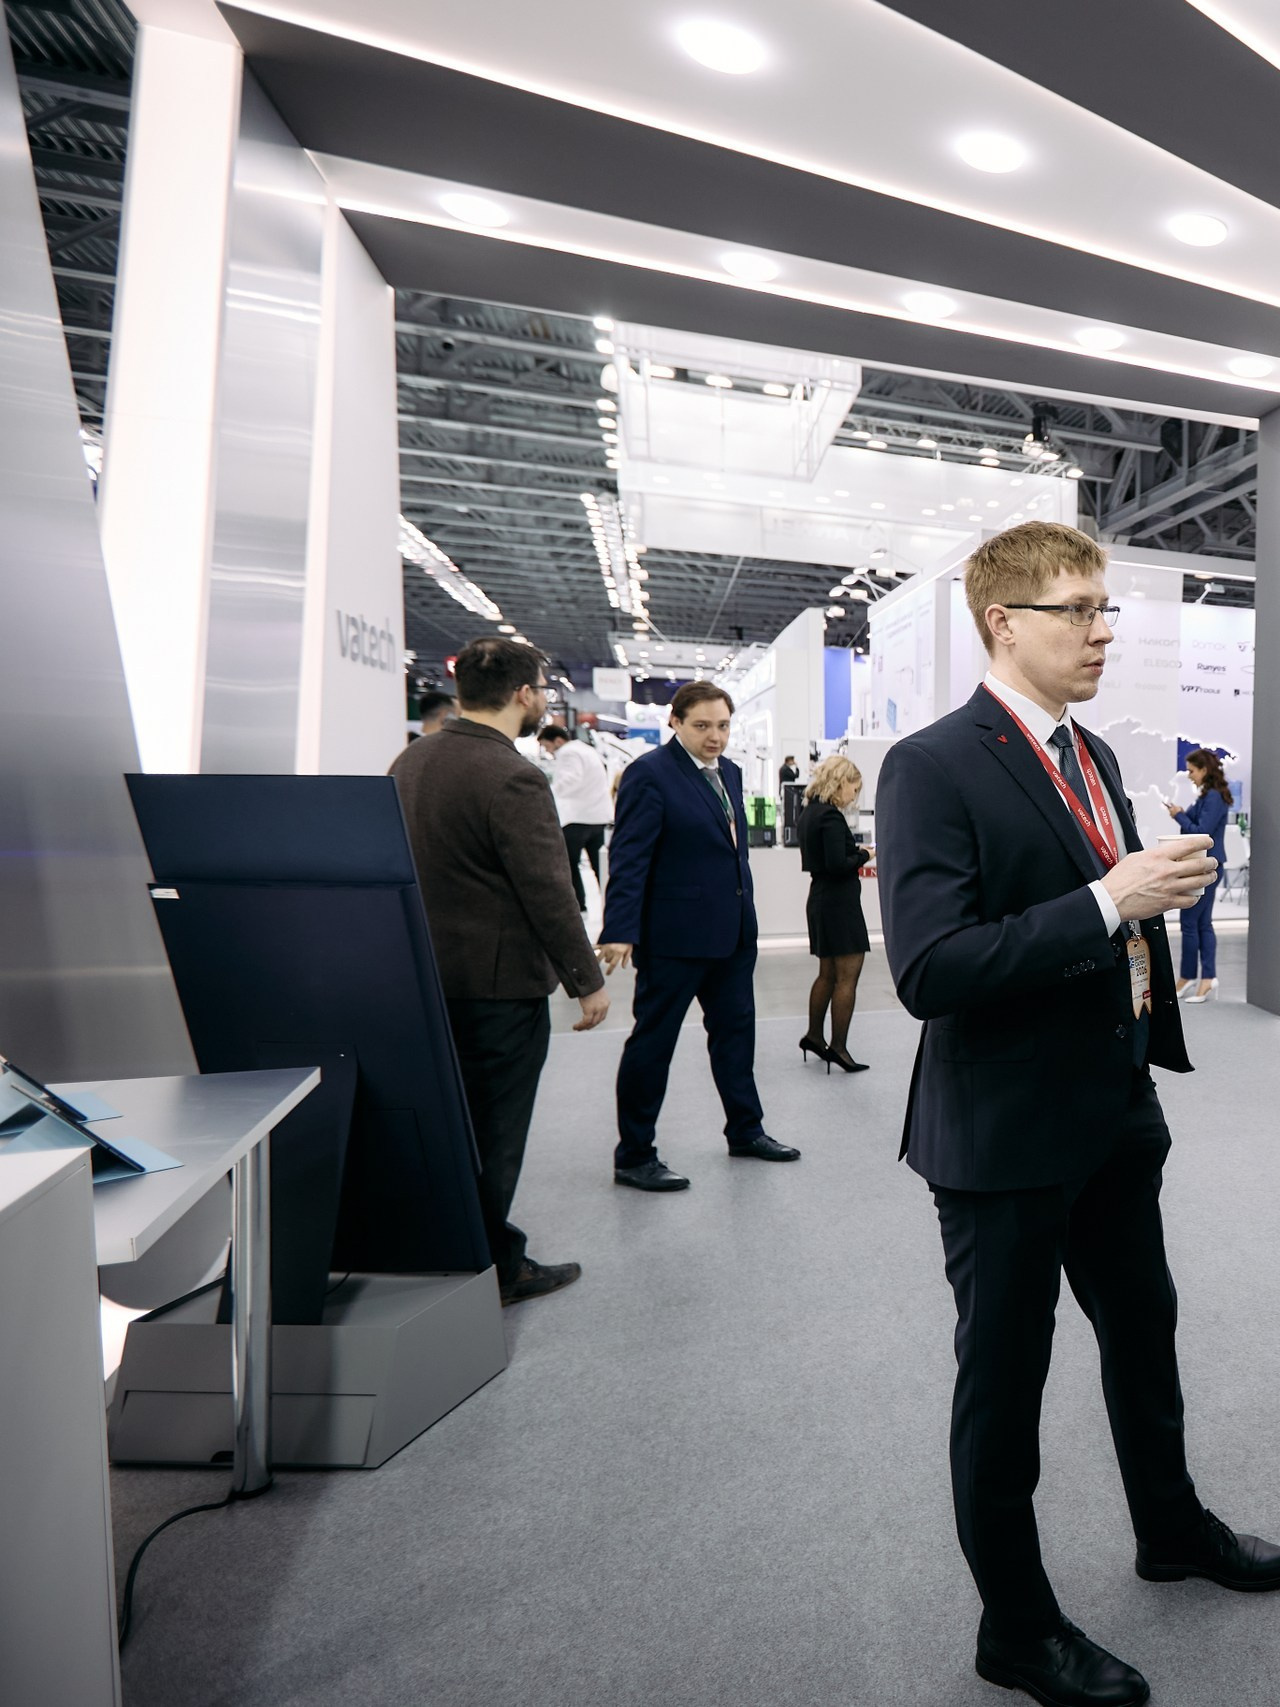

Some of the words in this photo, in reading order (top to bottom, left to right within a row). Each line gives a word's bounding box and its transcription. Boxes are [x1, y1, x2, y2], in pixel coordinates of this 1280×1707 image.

[336, 609, 396, 674] vatech
[1026, 733, 1041, 752] vatech
[1052, 770, 1067, 789] vatech
[1077, 807, 1091, 827] vatech
[1100, 846, 1113, 865] vatech
